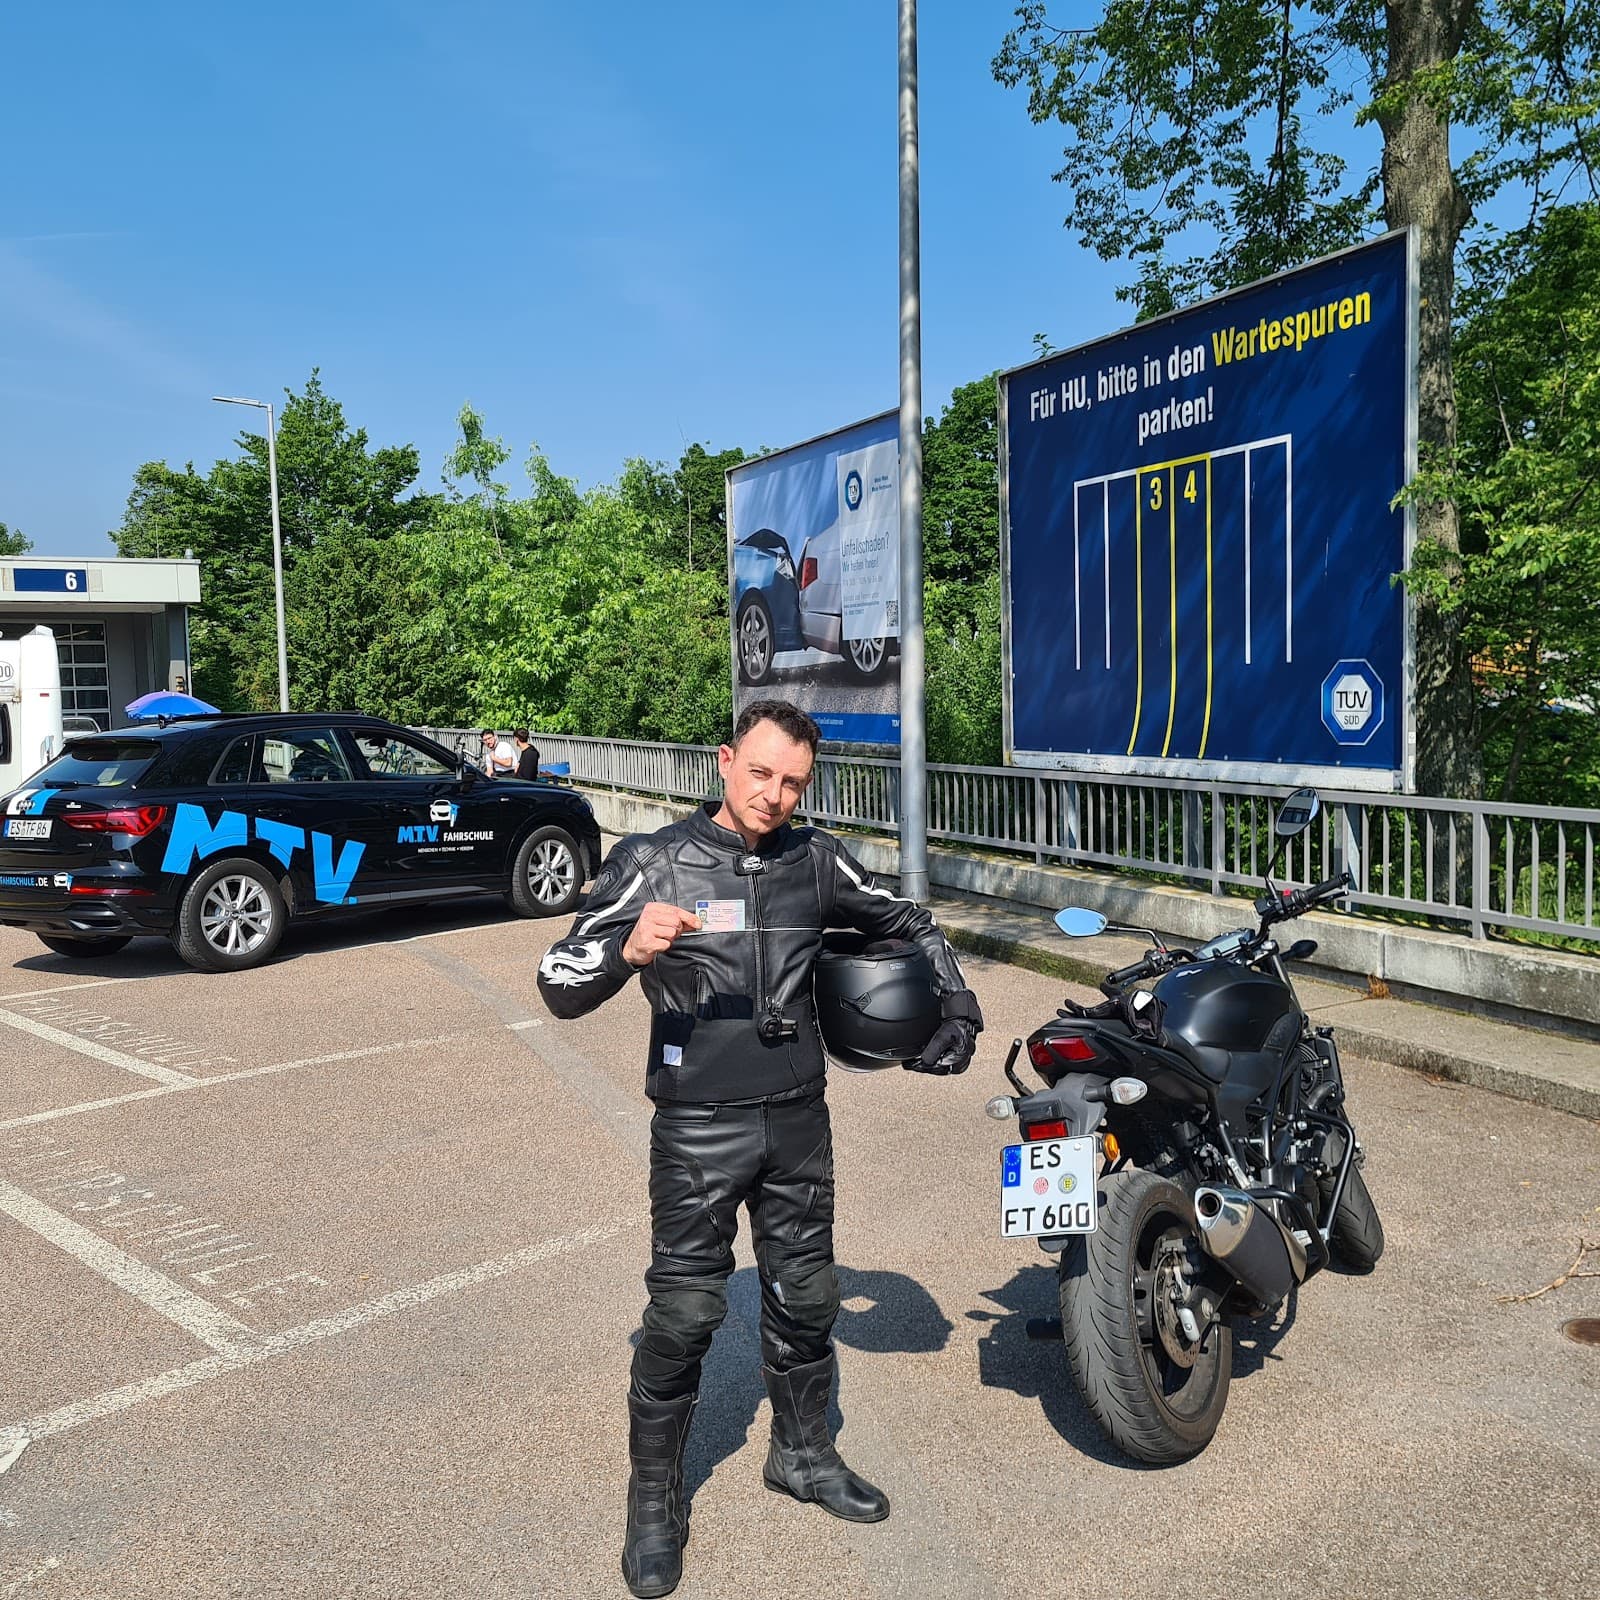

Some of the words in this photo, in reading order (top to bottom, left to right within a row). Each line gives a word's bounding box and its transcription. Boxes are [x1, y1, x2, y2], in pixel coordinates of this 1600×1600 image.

[1030, 384, 1057, 422] Für
[1061, 375, 1092, 411] HU,
[1098, 362, 1138, 403] bitte
[1143, 354, 1161, 389] in
[1168, 344, 1205, 382] den
[1212, 291, 1371, 367] Wartespuren
[1138, 386, 1214, 446] parken!
[1150, 477, 1163, 510] 3
[1183, 469, 1197, 503] 4
[65, 571, 77, 591] 6
[1336, 690, 1368, 709] TÜV
[10, 822, 20, 835] ES
[443, 831, 494, 842] FAHRSCHULE
[1030, 1144, 1061, 1170] ES
[1008, 1171, 1016, 1183] D
[1005, 1207, 1036, 1233] FT
[1042, 1202, 1090, 1230] 600
